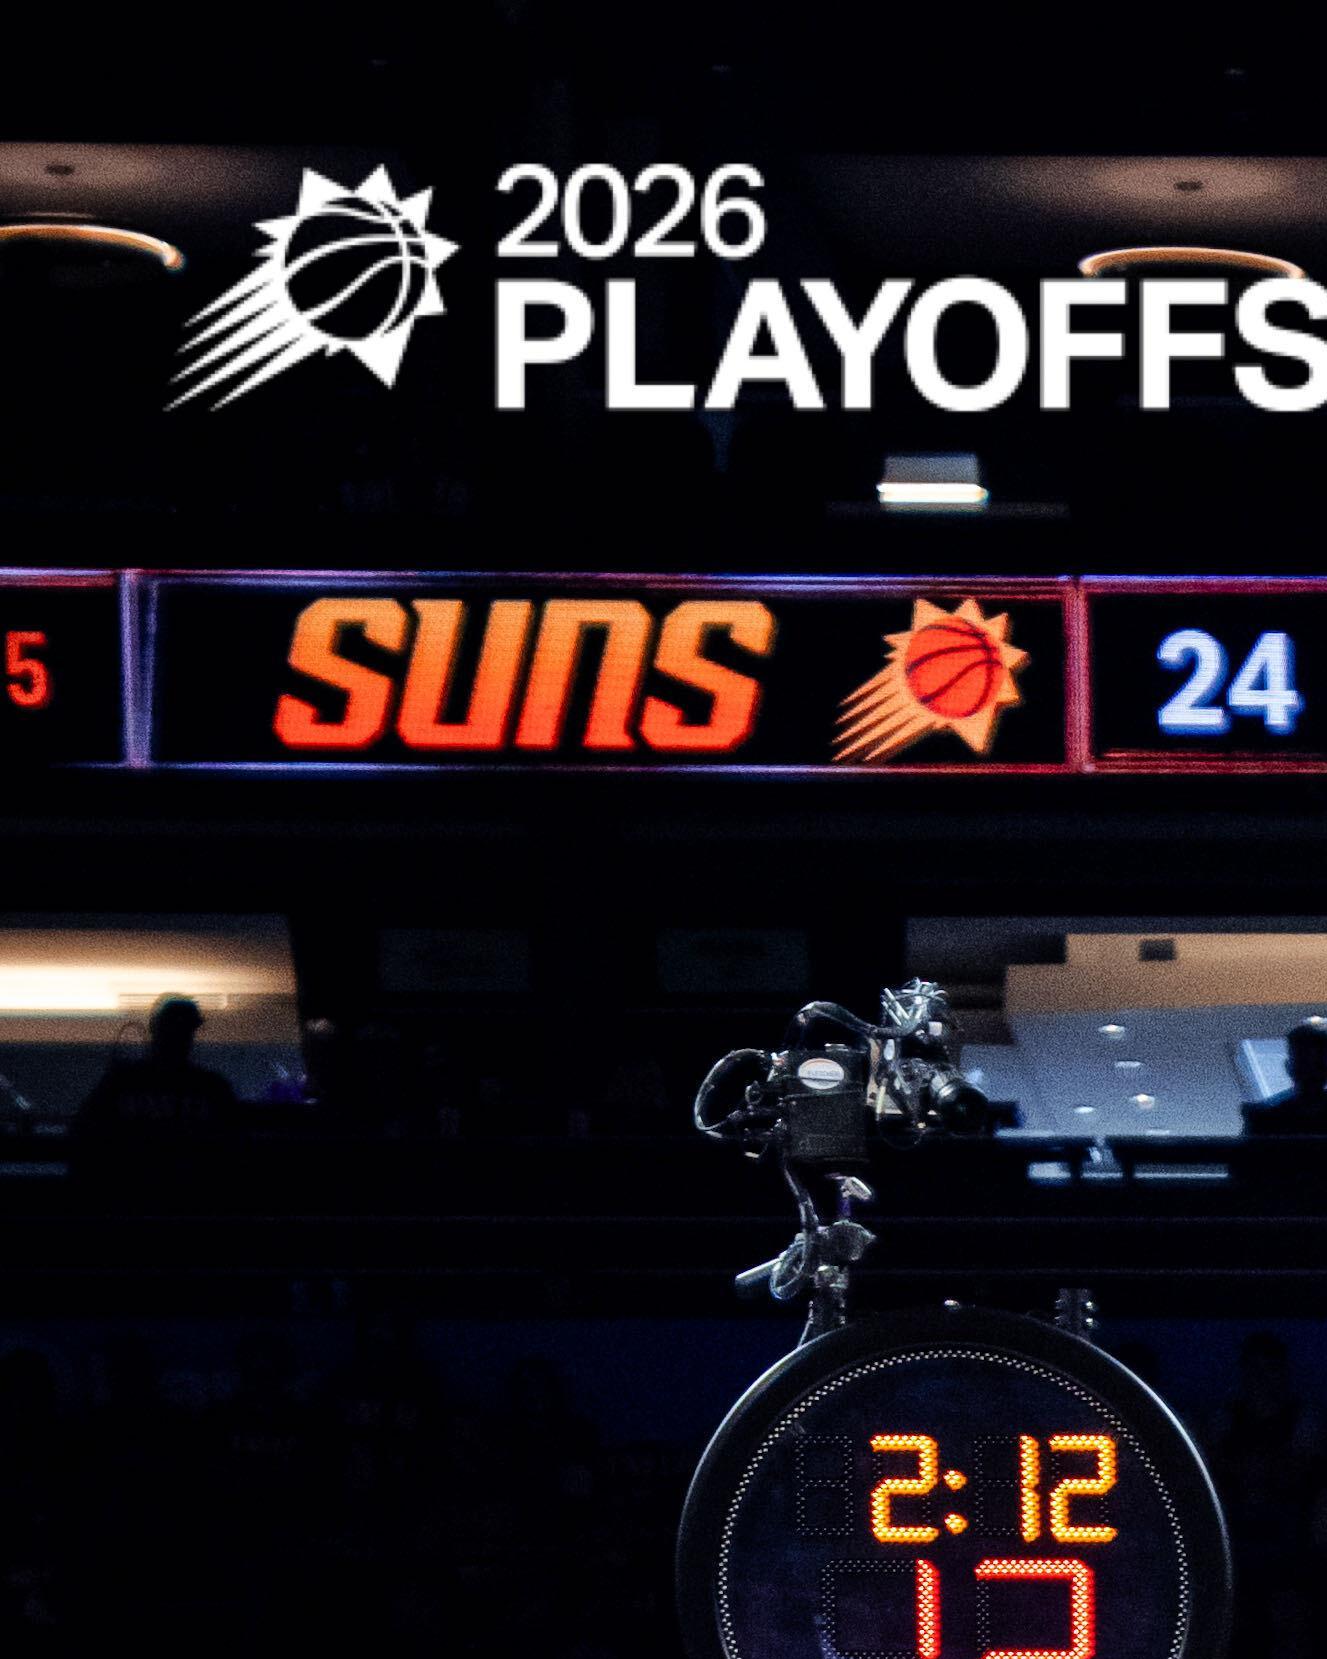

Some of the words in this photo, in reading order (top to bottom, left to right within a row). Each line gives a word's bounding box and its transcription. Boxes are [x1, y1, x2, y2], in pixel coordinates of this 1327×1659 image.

[6, 632, 48, 706] 5
[274, 599, 774, 750] SUNS
[1157, 629, 1301, 734] 24
[870, 1434, 1118, 1543] 2:12
